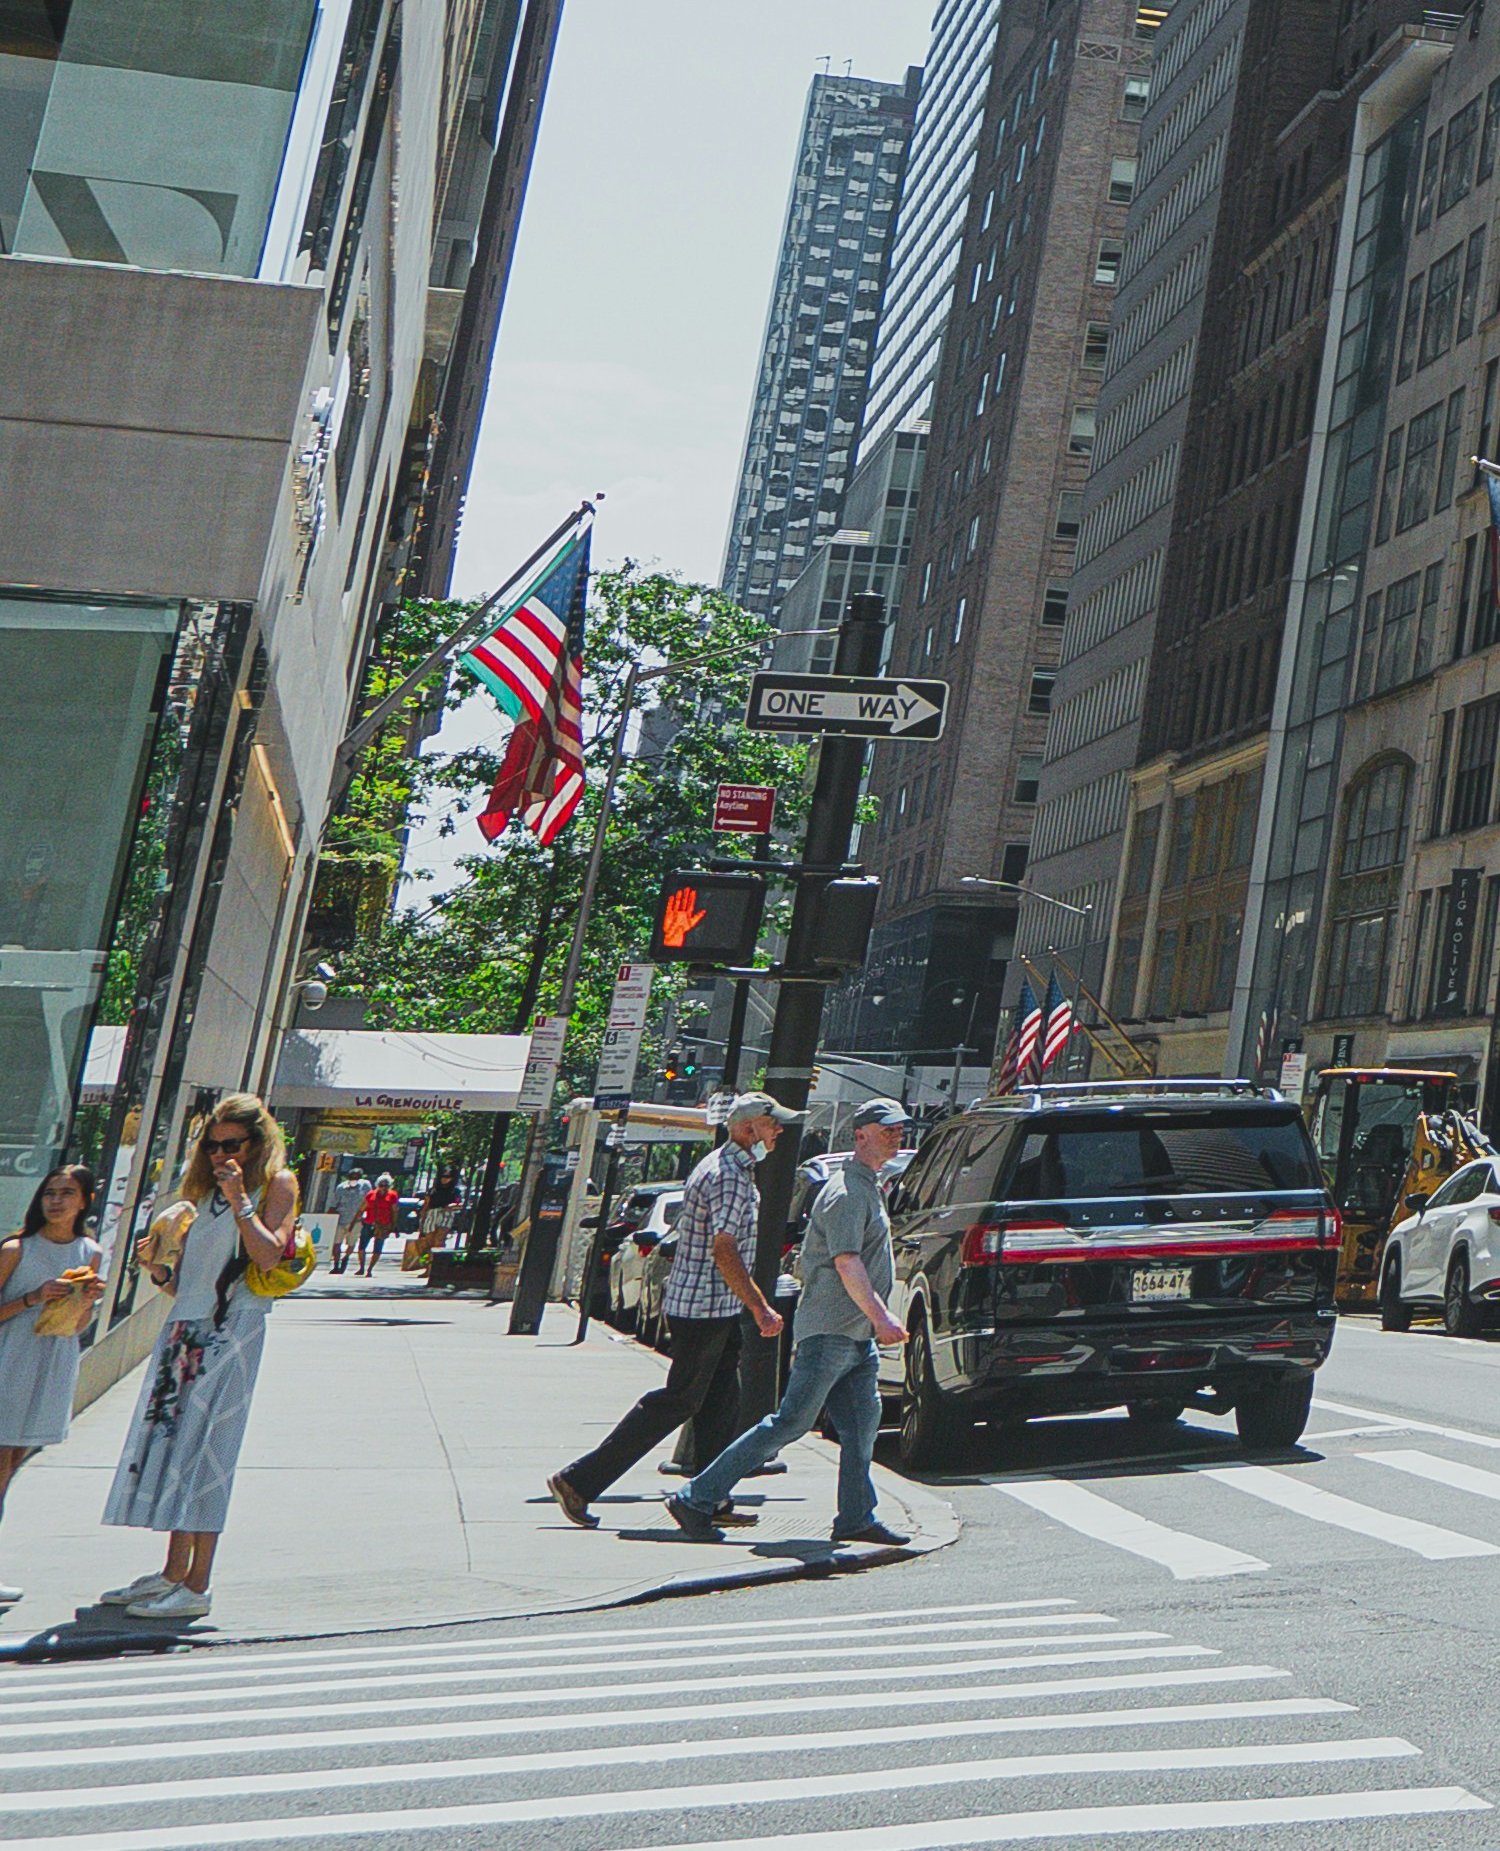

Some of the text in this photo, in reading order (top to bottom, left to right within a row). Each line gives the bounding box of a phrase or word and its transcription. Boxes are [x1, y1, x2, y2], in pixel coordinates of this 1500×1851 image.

[767, 692, 920, 720] ONE WAY
[720, 790, 768, 801] NO STANDING
[1457, 878, 1468, 910] FIG
[1448, 932, 1463, 989] OLIVE
[355, 1096, 372, 1107] LA
[1082, 1208, 1254, 1221] LINCOLN
